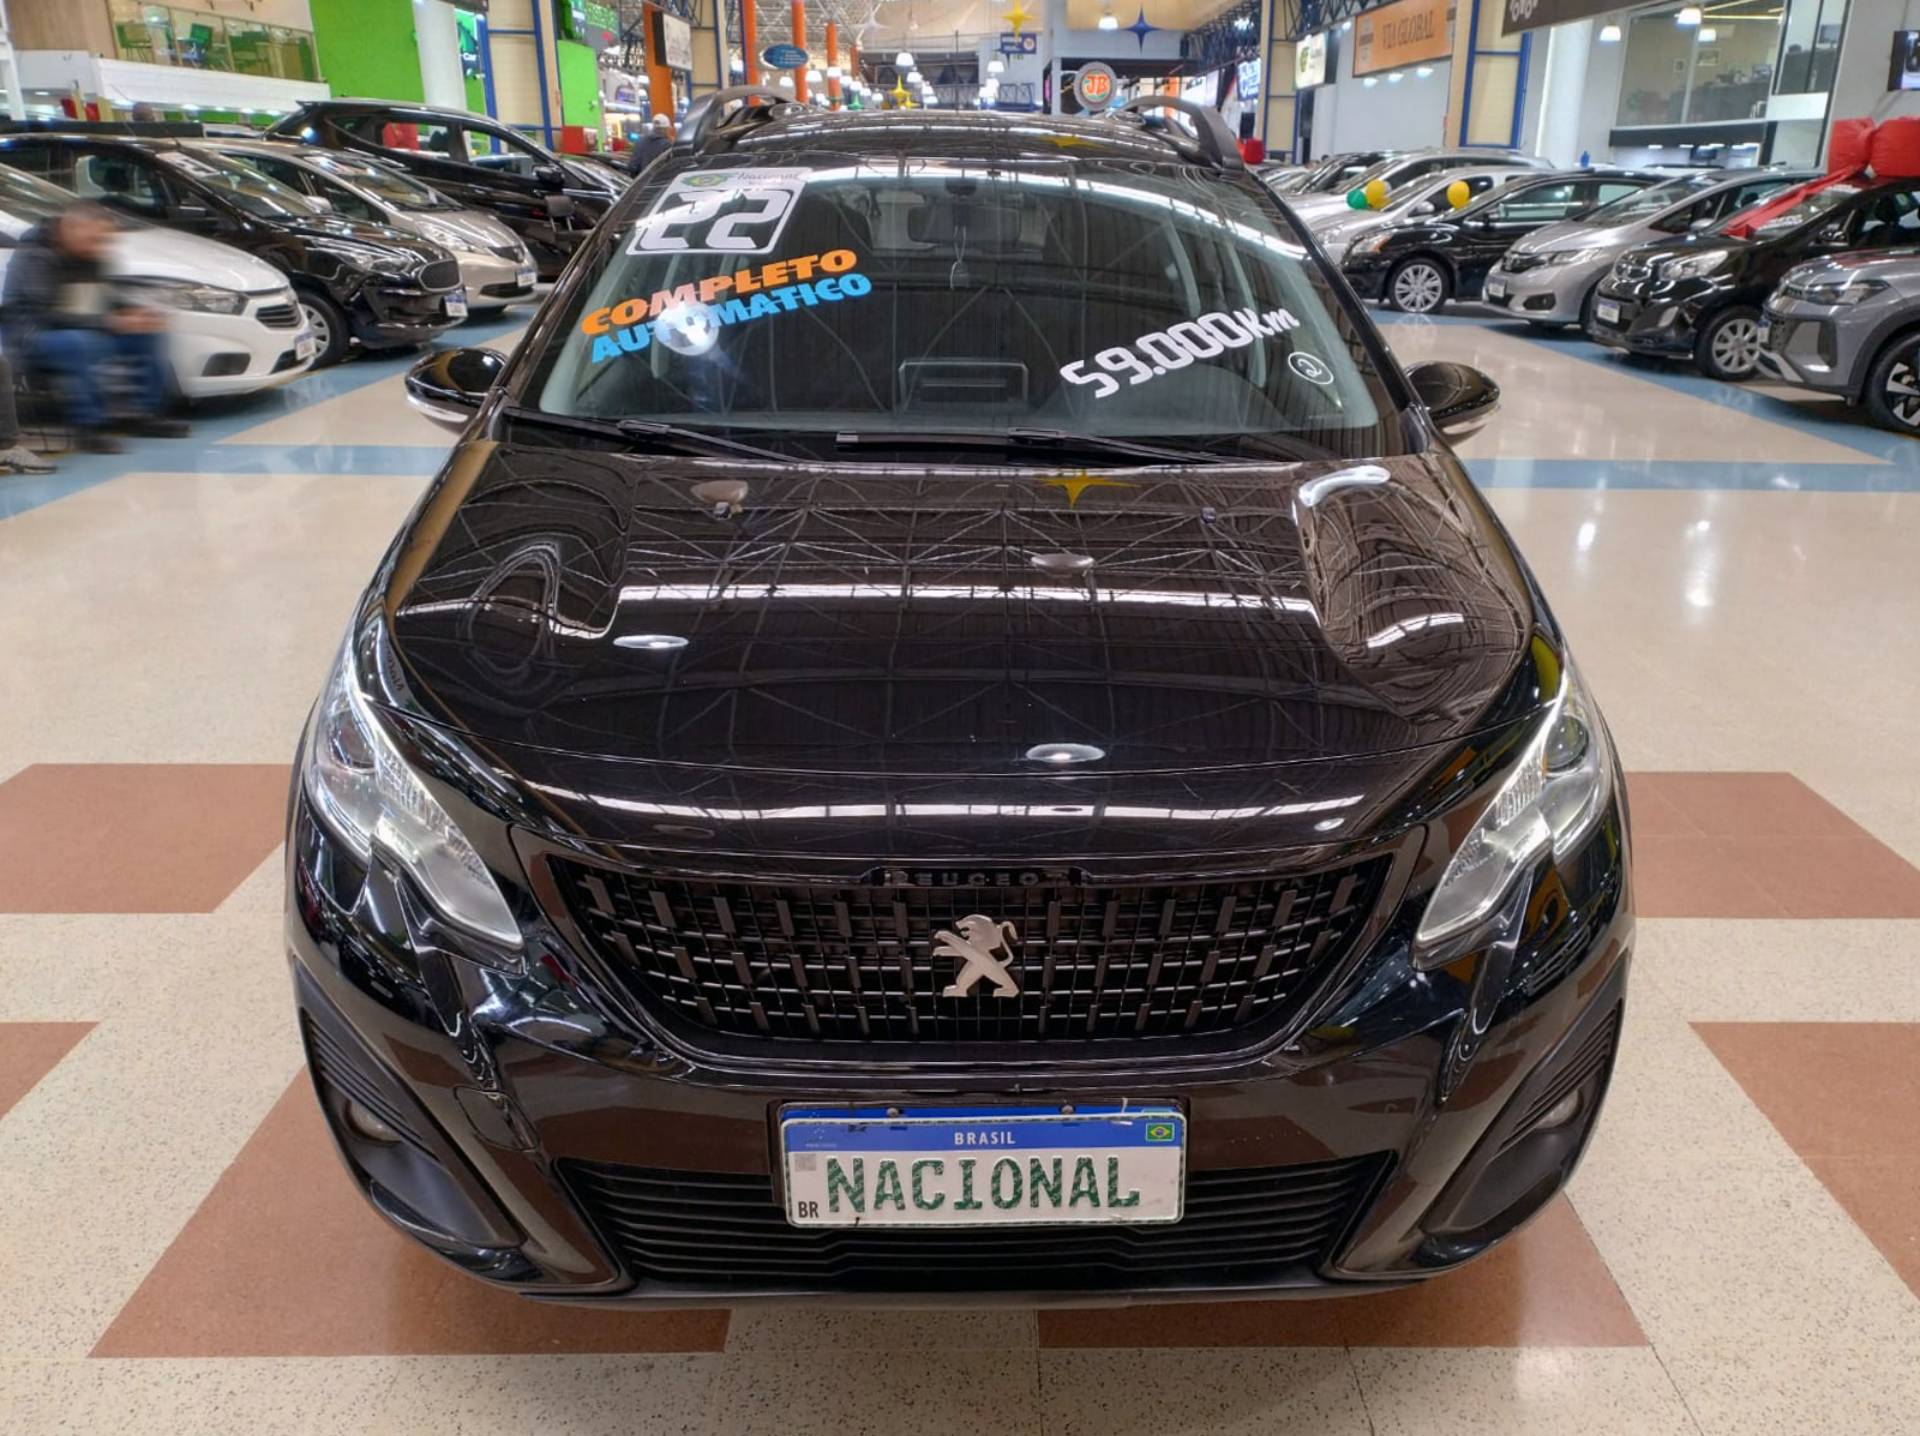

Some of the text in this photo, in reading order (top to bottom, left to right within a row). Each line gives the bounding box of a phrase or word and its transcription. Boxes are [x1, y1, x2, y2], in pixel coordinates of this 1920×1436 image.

[1087, 75, 1109, 95] JB
[639, 189, 793, 250] 22
[581, 249, 857, 335] COMPLETO
[591, 273, 872, 364] AUTOMATICO
[954, 1131, 1016, 1146] BRASIL
[798, 1200, 819, 1219] BR
[827, 1156, 1141, 1214] NACIONAL
